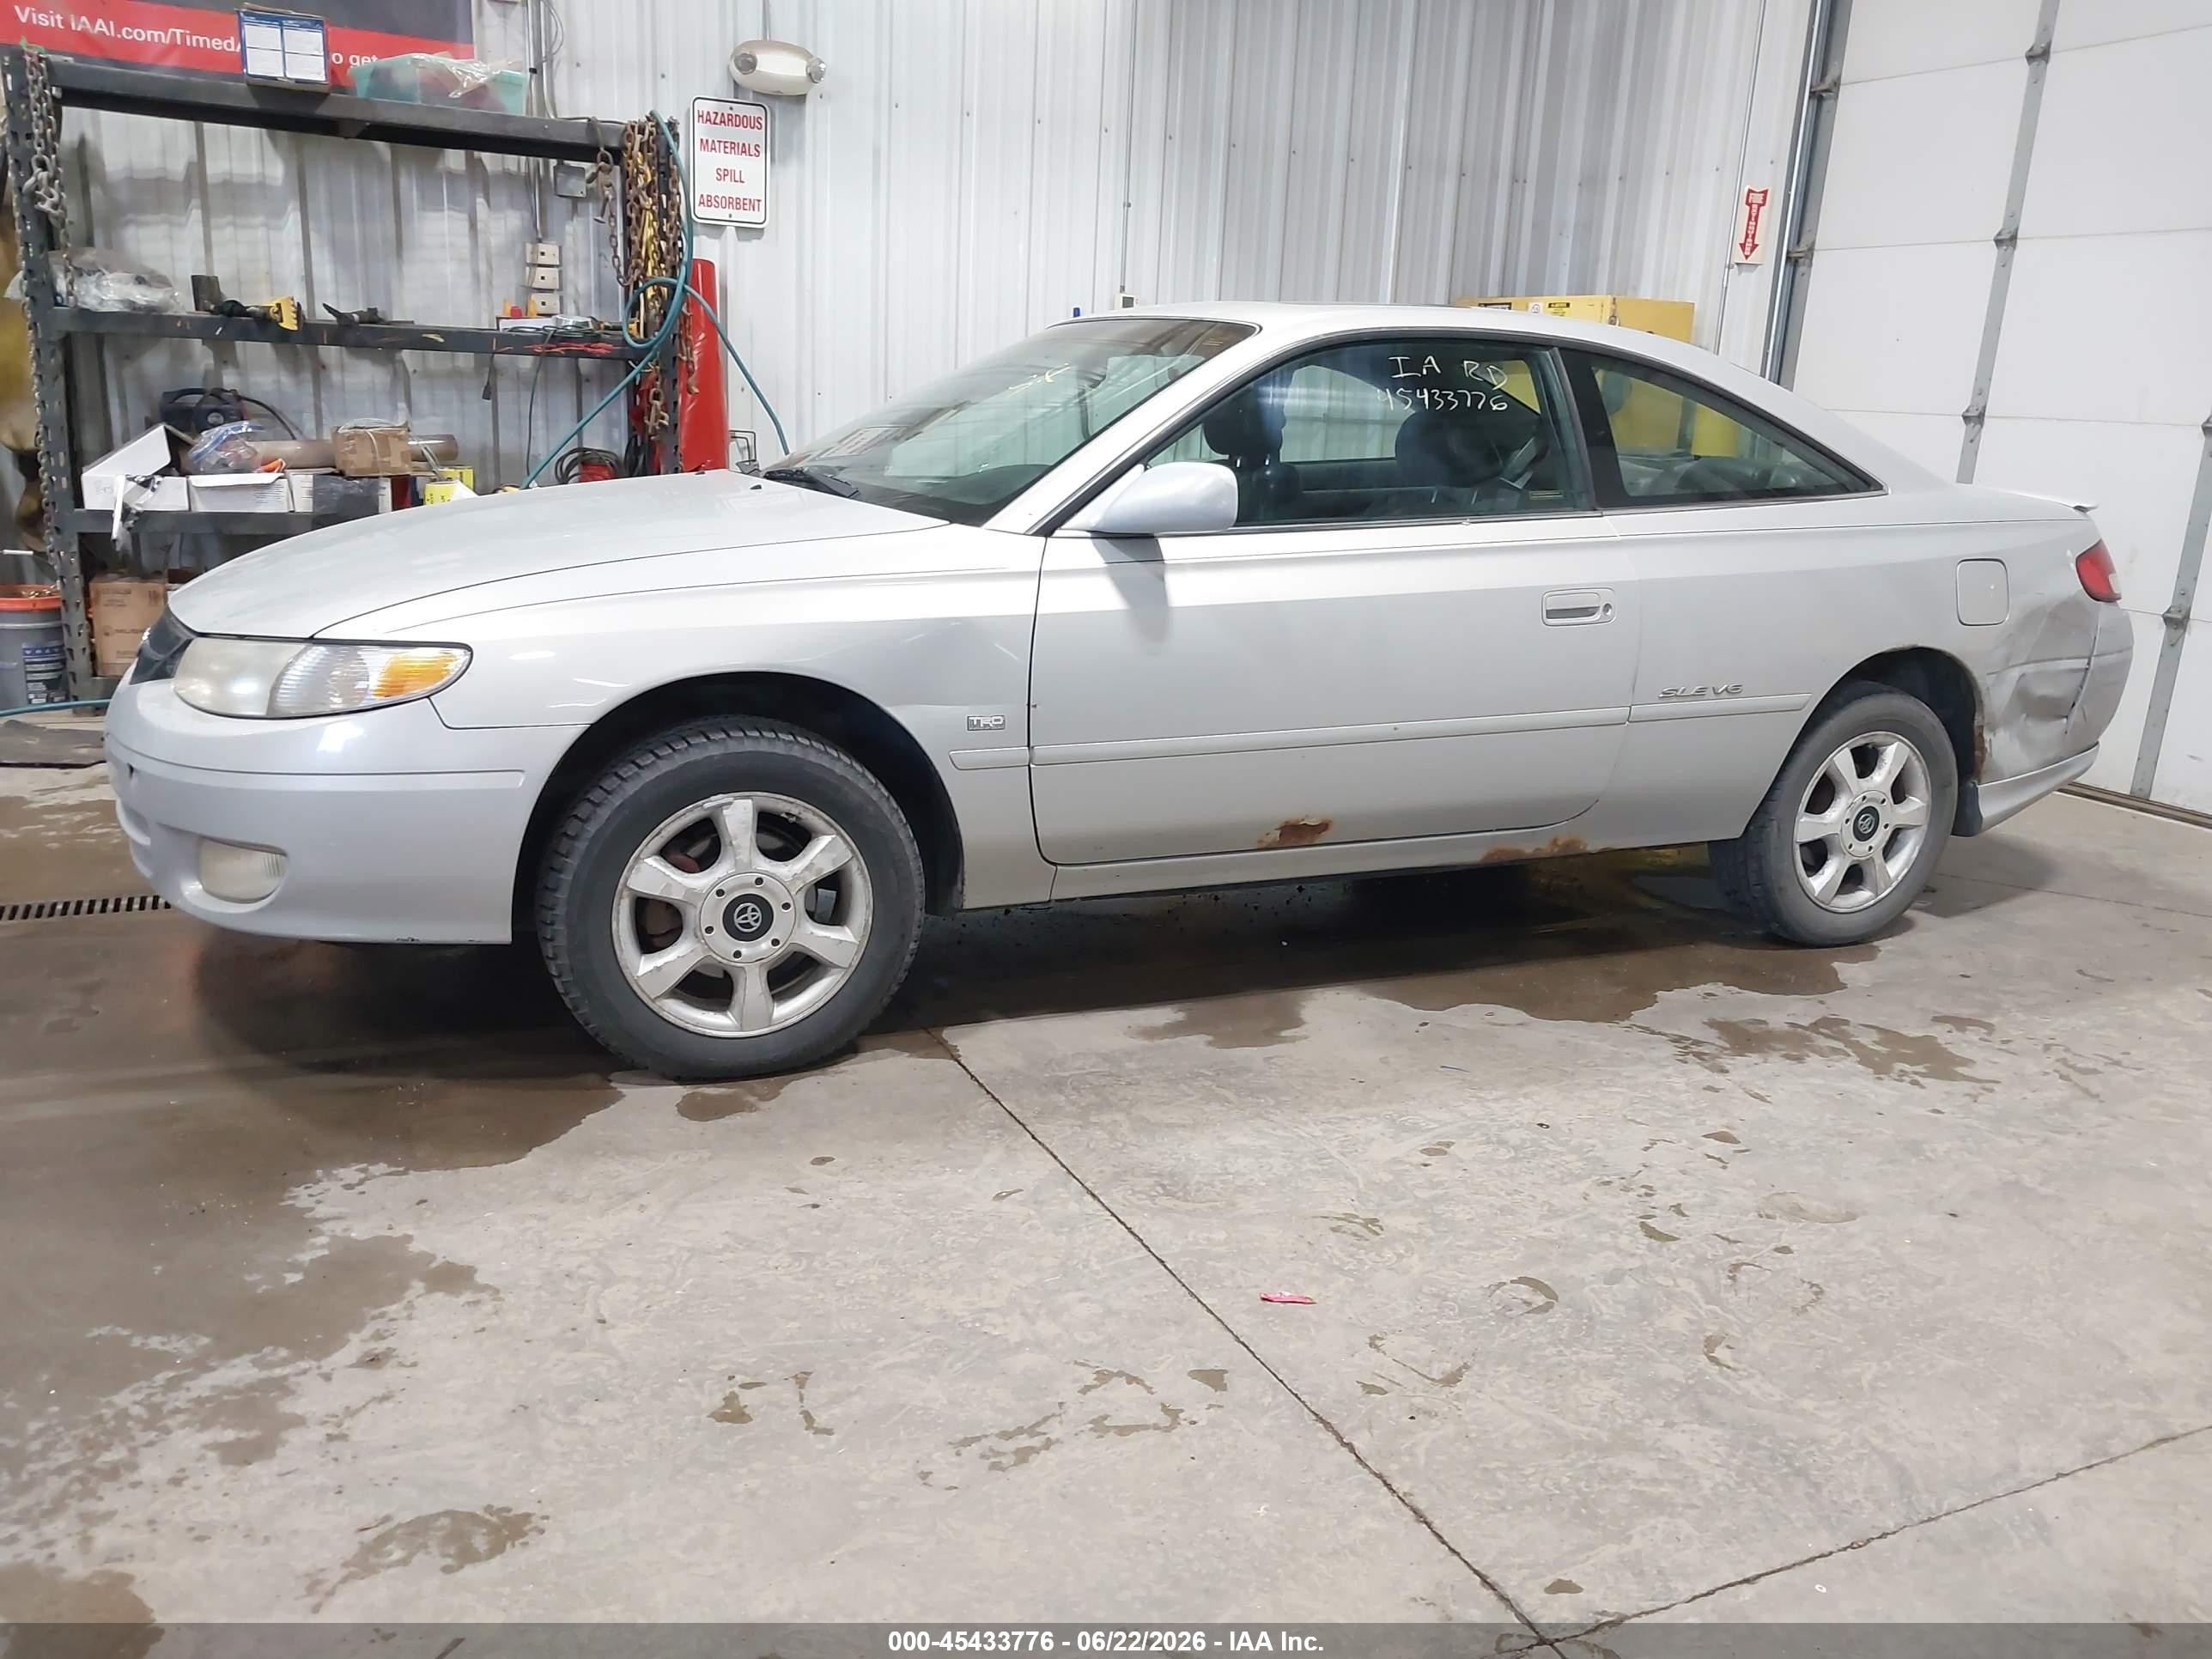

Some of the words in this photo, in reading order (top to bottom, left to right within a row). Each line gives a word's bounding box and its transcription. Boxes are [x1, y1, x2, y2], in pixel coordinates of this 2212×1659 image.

[15, 4, 64, 29] Visit
[697, 109, 763, 130] HAZARDOUS
[700, 138, 761, 158] MATERIALS
[715, 167, 745, 184] SPILL
[698, 194, 762, 212] ABSORBENT
[1377, 387, 1509, 411] 45433776
